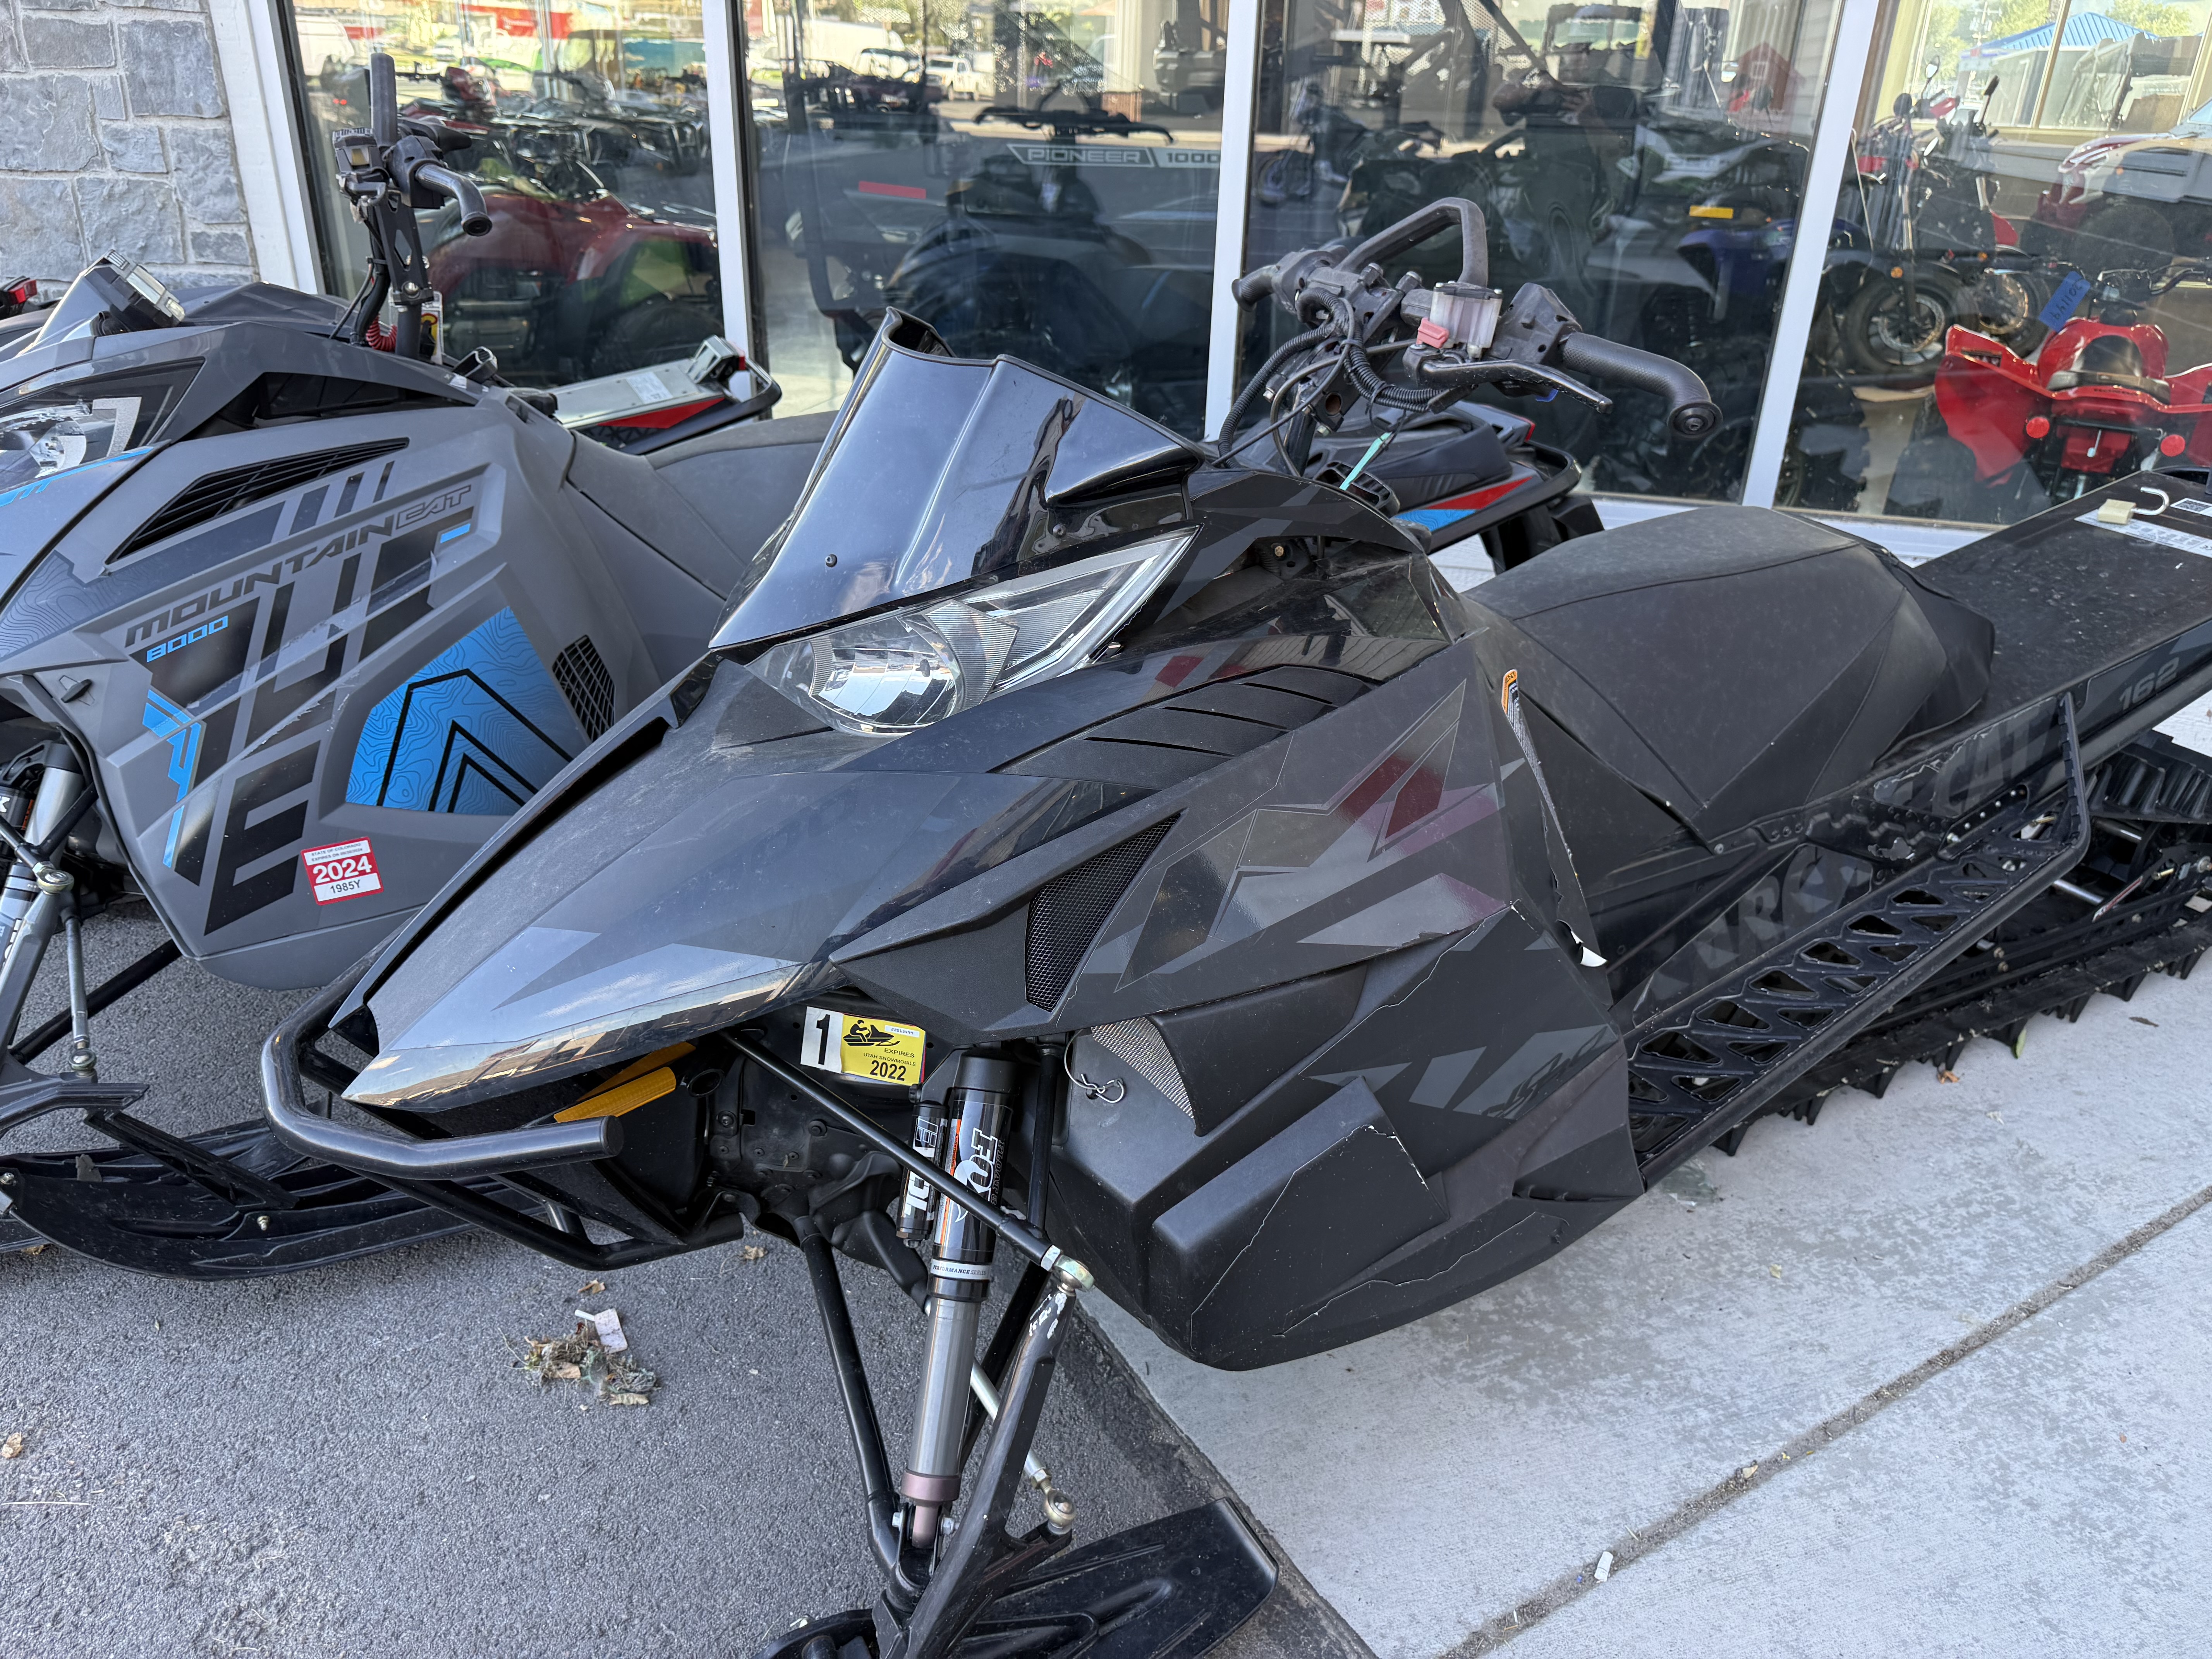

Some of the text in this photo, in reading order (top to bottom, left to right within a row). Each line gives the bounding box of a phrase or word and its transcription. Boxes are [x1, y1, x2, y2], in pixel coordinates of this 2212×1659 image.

[1027, 148, 1221, 163] PIONEER 1000
[124, 484, 472, 648] MOUNTAIN CAT
[146, 615, 229, 663] 8000
[2119, 657, 2179, 711] 162
[313, 855, 373, 884] 2024
[330, 879, 361, 894] 1985Y
[816, 1014, 831, 1065] 1
[879, 1056, 916, 1066] SNOWMOBILE
[884, 1048, 915, 1058] EXPIRES
[869, 1060, 907, 1081] 2022
[991, 1139, 1005, 1194] FLOAT
[933, 1265, 970, 1274] PERFORMANCE
